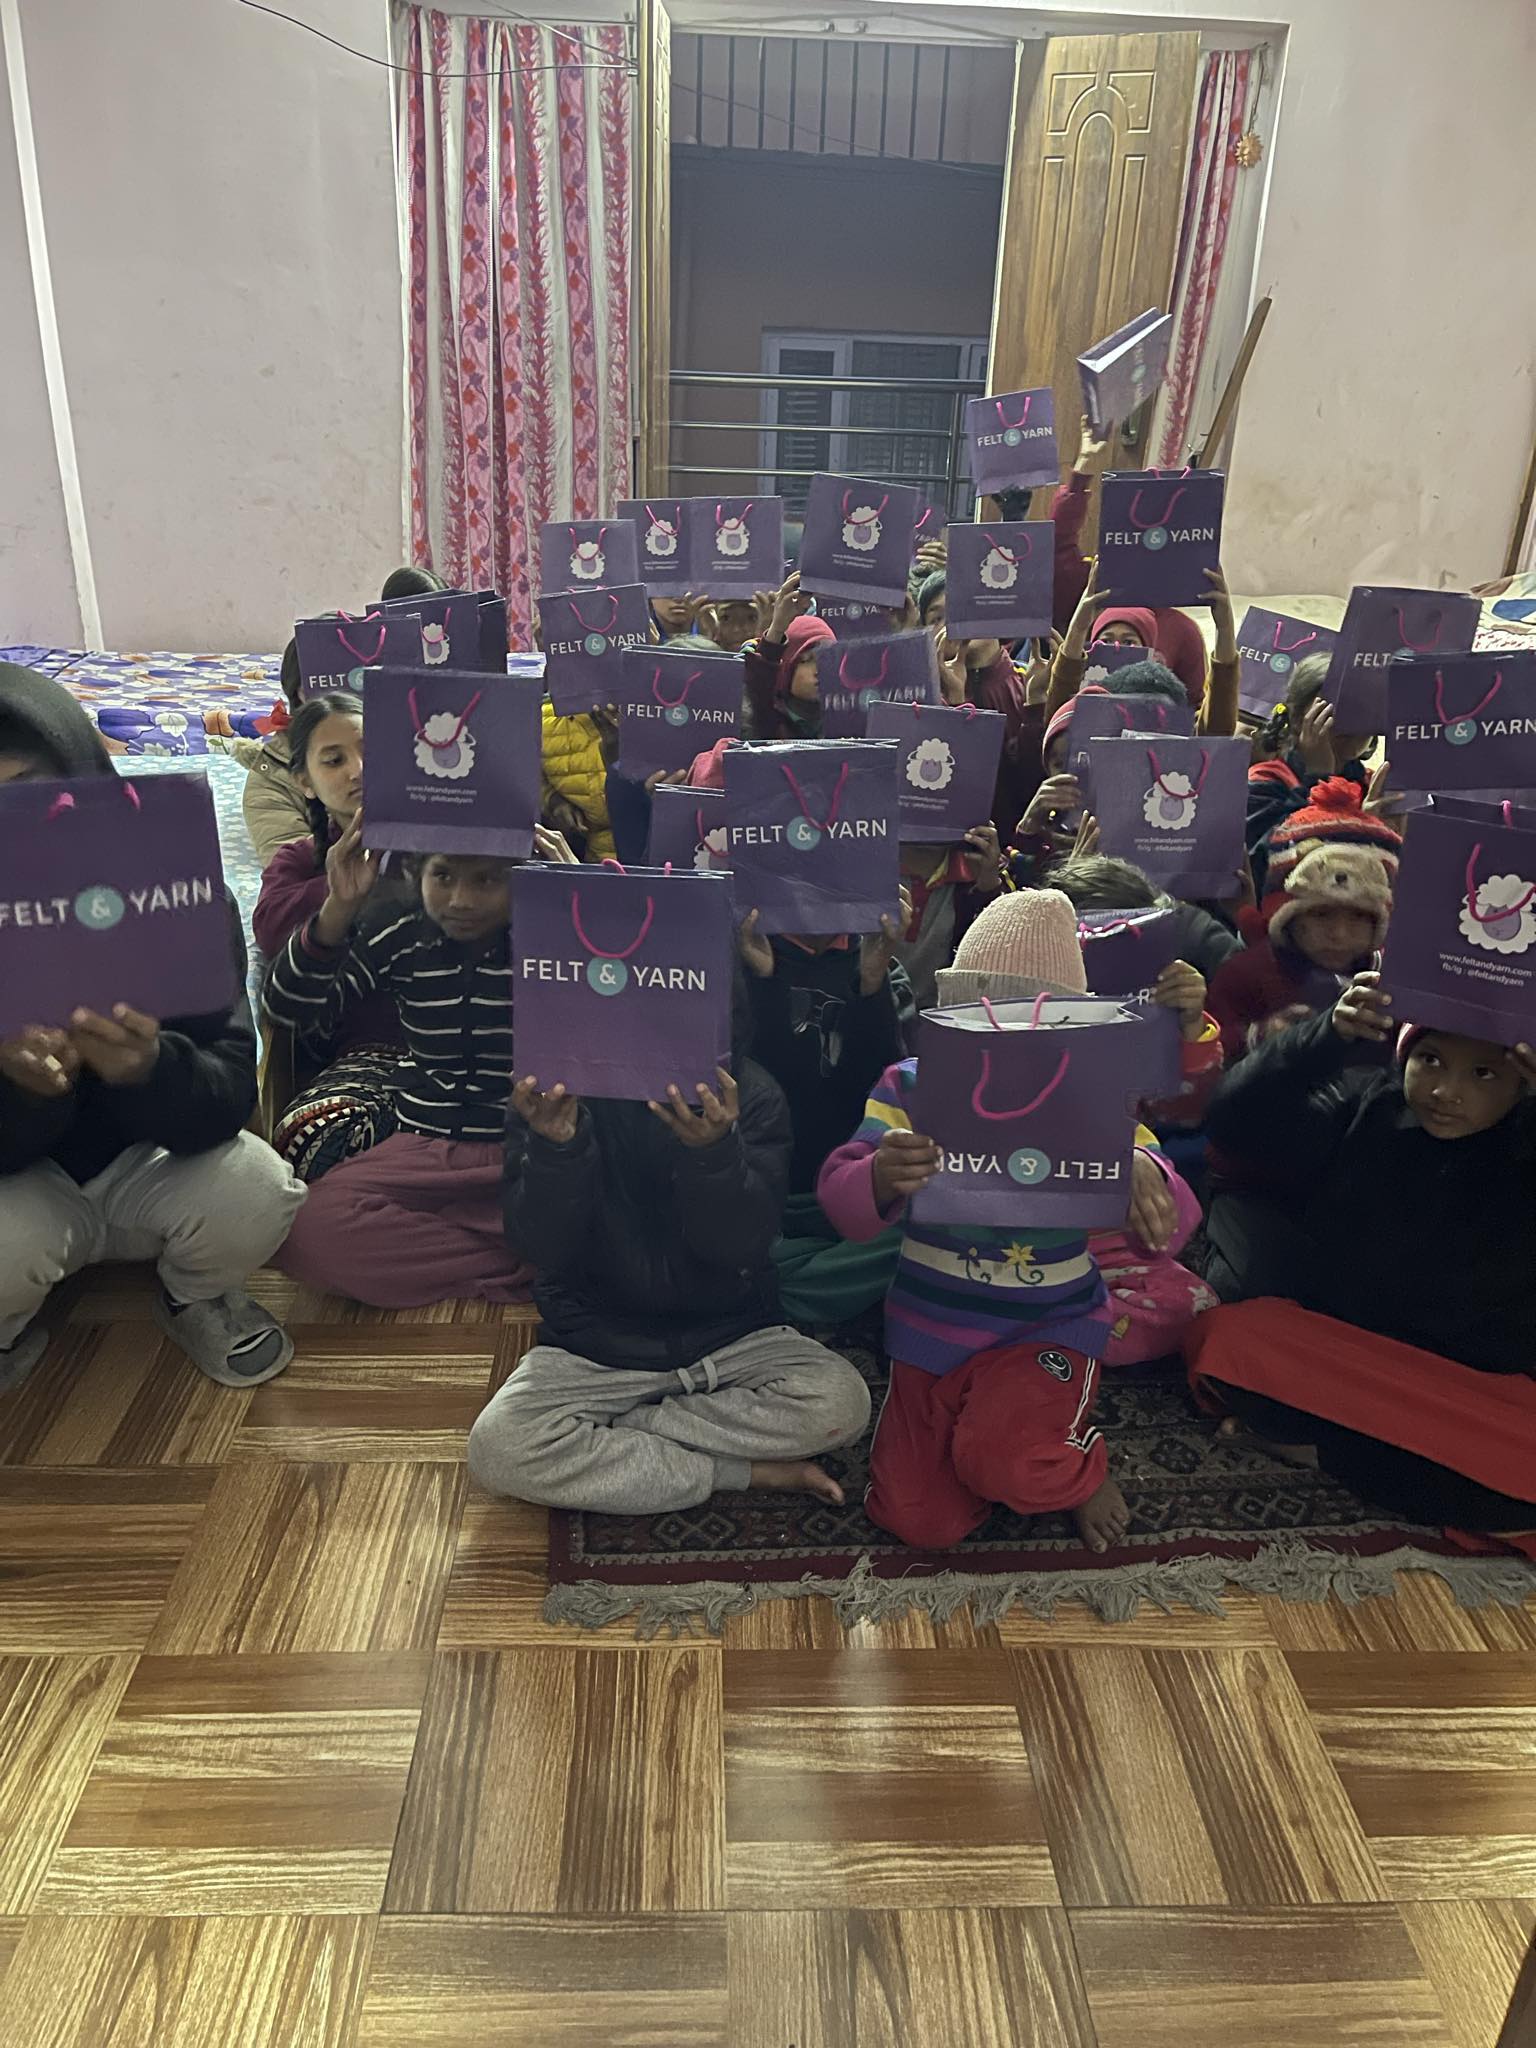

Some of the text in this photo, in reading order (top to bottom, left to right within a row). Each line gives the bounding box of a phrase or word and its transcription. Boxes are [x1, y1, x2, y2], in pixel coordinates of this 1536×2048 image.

[977, 433, 1003, 447] FELT
[1021, 427, 1052, 439] YARN
[1105, 531, 1142, 545] FELT
[1171, 528, 1214, 542] YARN
[821, 606, 845, 617] FELT
[864, 604, 880, 615] YA
[550, 640, 582, 655] FELT
[608, 632, 646, 647] YARN
[1240, 646, 1271, 663] FELT
[1353, 652, 1391, 667] FELT
[309, 674, 345, 688] FELT
[627, 703, 663, 719] FELT
[692, 709, 735, 723] YARN
[1395, 724, 1443, 740] FELT
[1481, 718, 1536, 736] YARN
[732, 825, 784, 845] FELT
[827, 818, 888, 840] YARN
[0, 899, 70, 927] FELT
[129, 877, 212, 915] YARN
[523, 958, 584, 982] FELT
[633, 966, 706, 991] YARN
[1439, 952, 1532, 977] www.feltandyarn.com
[1054, 1160, 1120, 1180] FELT
